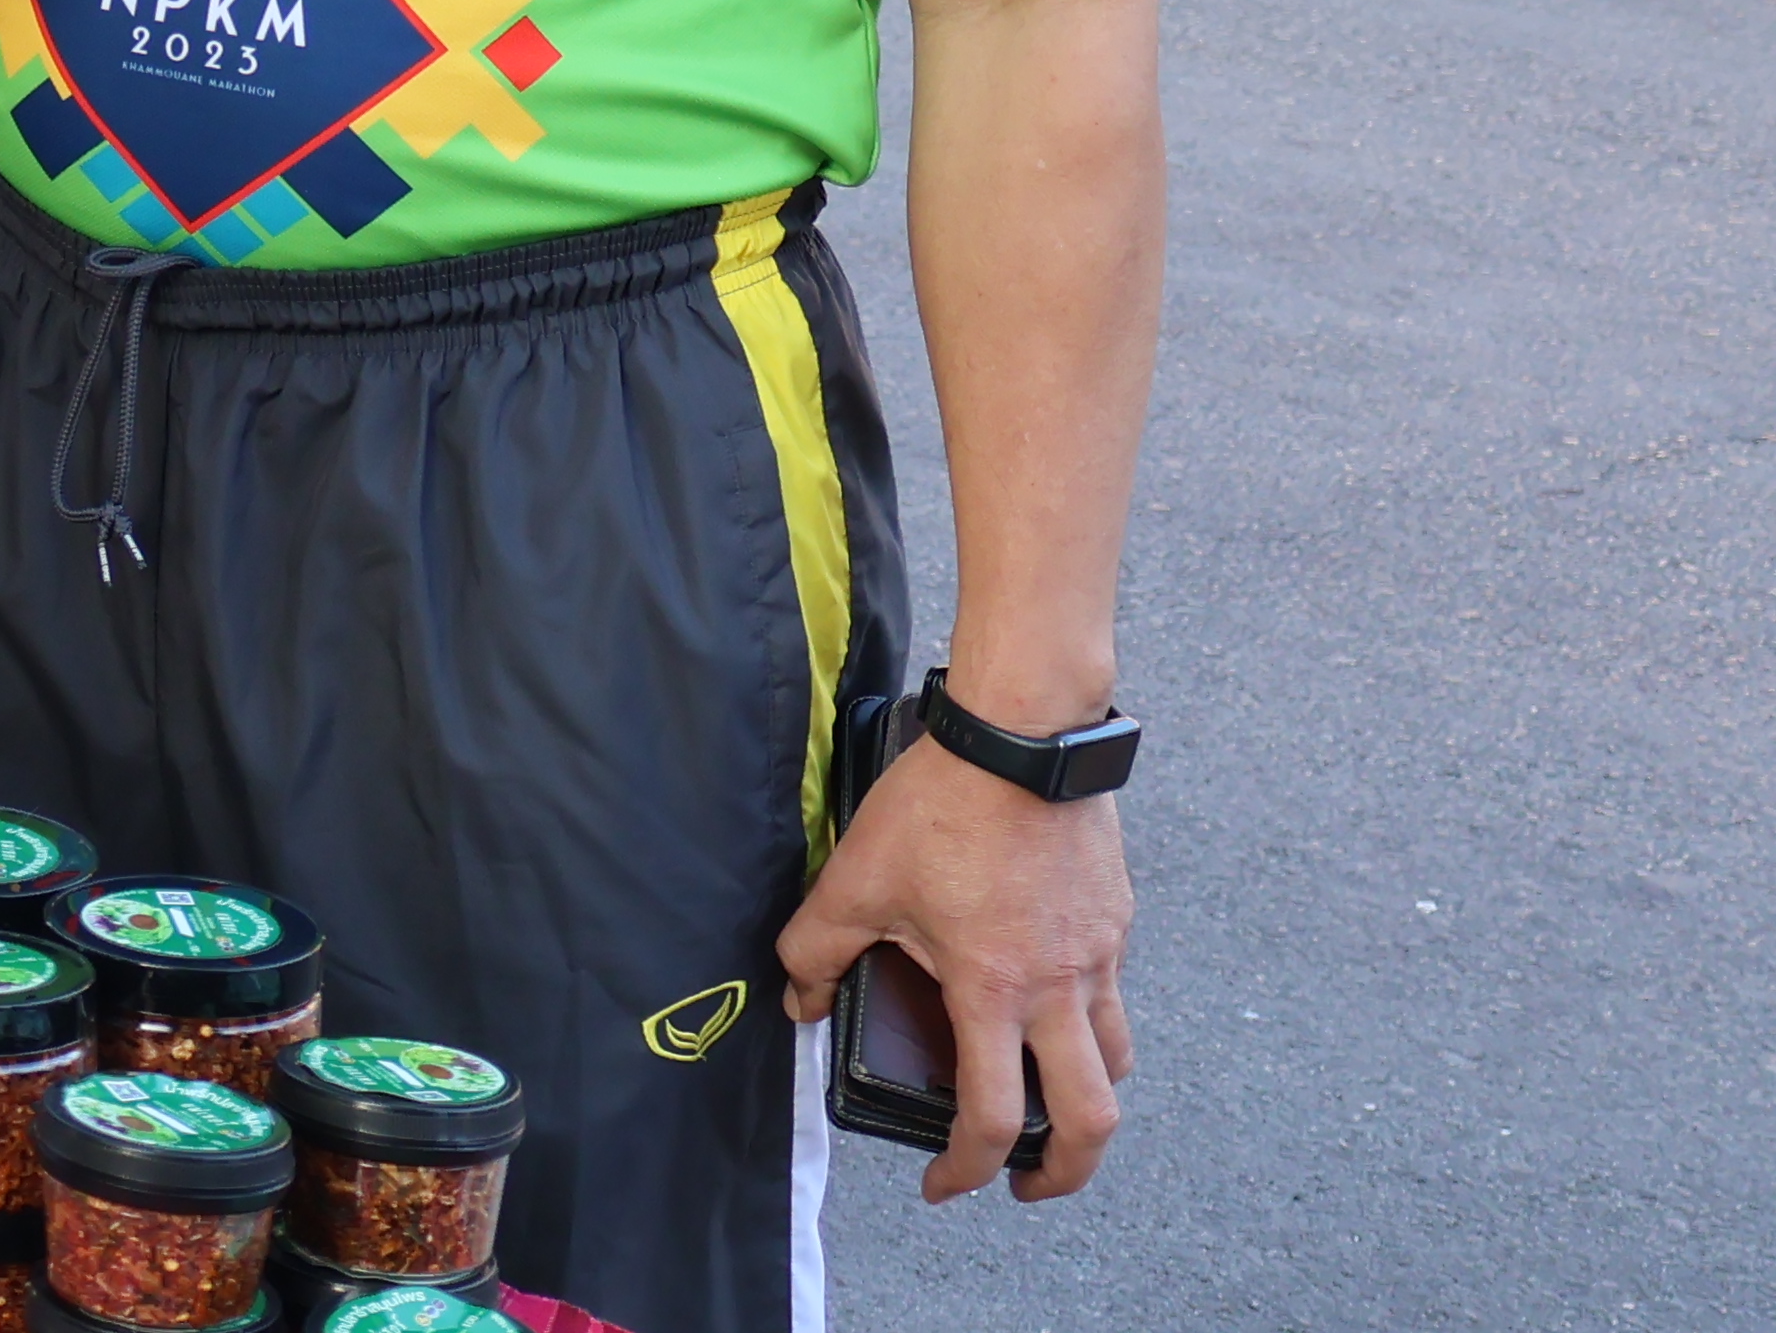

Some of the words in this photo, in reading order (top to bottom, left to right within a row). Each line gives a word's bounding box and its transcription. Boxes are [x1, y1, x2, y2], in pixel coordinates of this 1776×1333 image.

[131, 26, 259, 76] 2023
[121, 60, 204, 87] KHAMMOUANE
[208, 77, 277, 99] MARATHON
